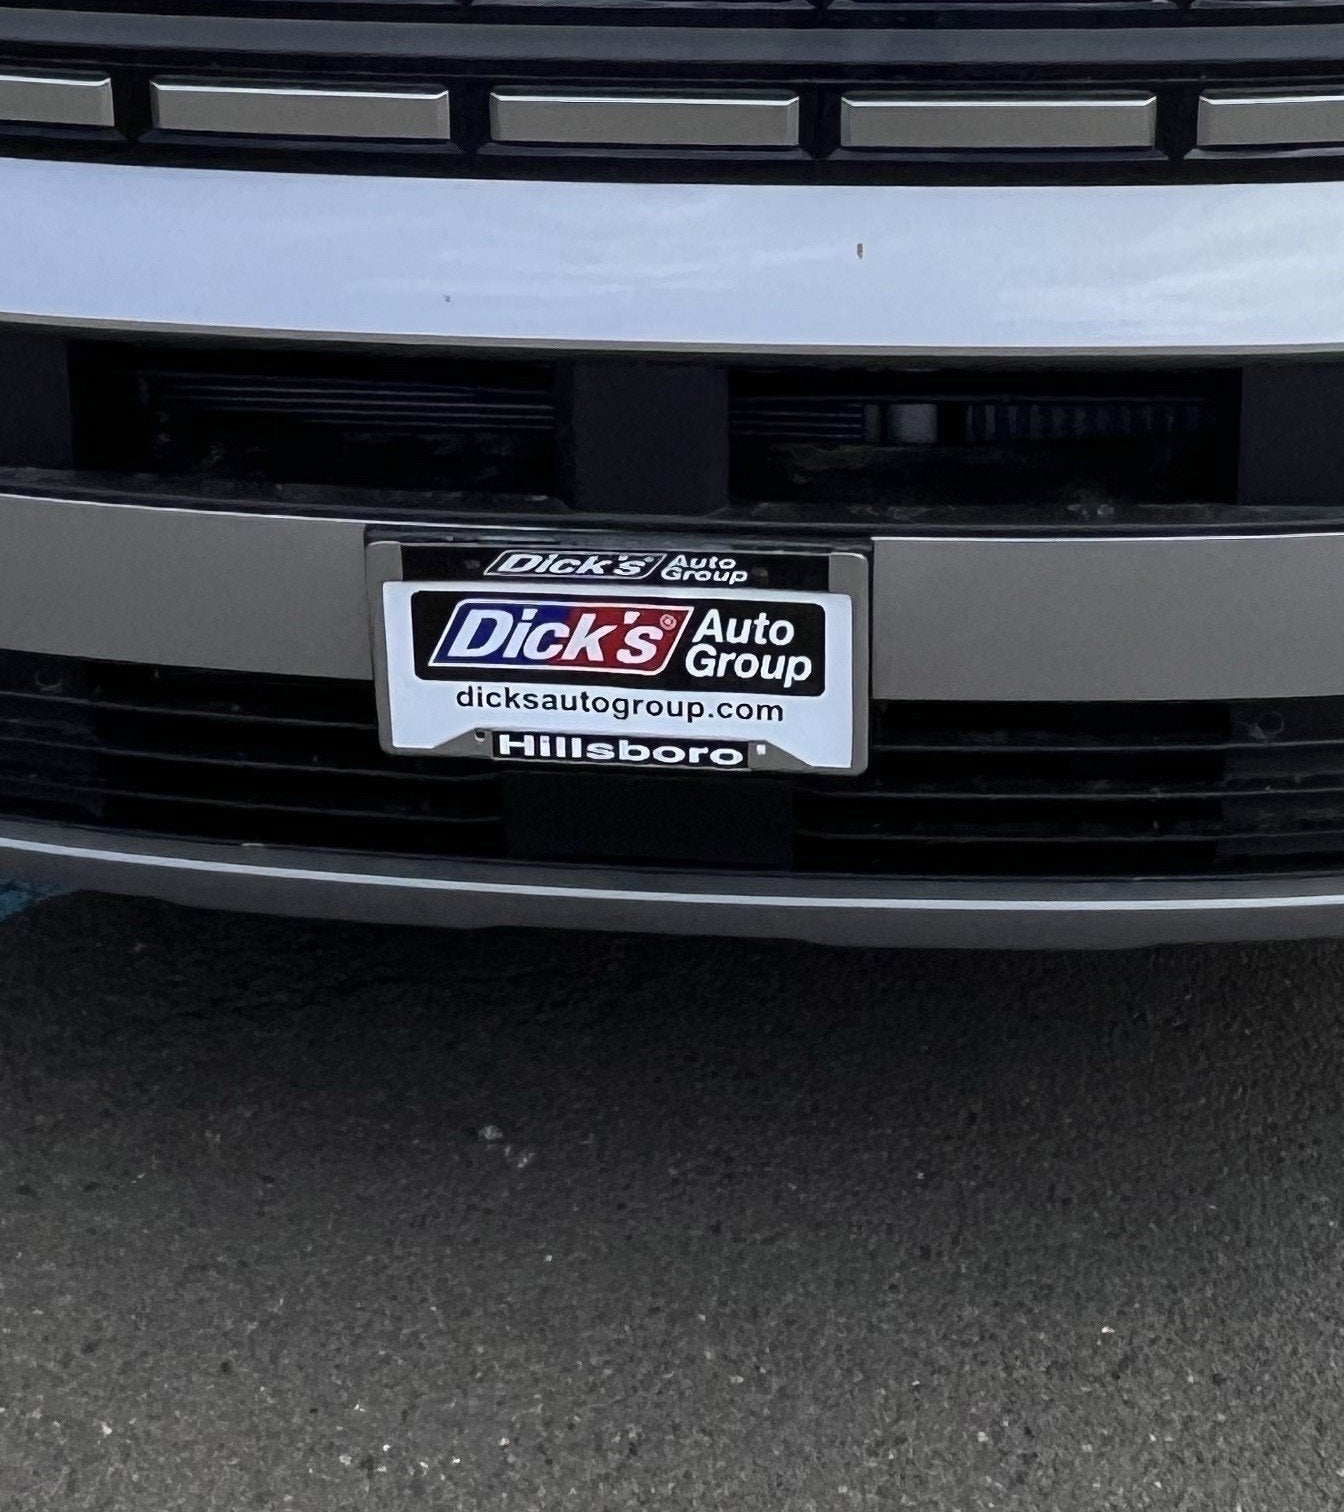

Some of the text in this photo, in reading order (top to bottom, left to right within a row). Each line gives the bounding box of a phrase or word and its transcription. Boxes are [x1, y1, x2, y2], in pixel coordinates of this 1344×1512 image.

[497, 553, 646, 576] Dick's
[660, 566, 748, 585] Group
[668, 554, 737, 569] Auto
[447, 607, 663, 665] Dick's
[691, 608, 795, 646] Auto
[685, 642, 813, 688] Group
[455, 686, 784, 722] dicksautogroup.com
[498, 732, 744, 767] Hillsboro
